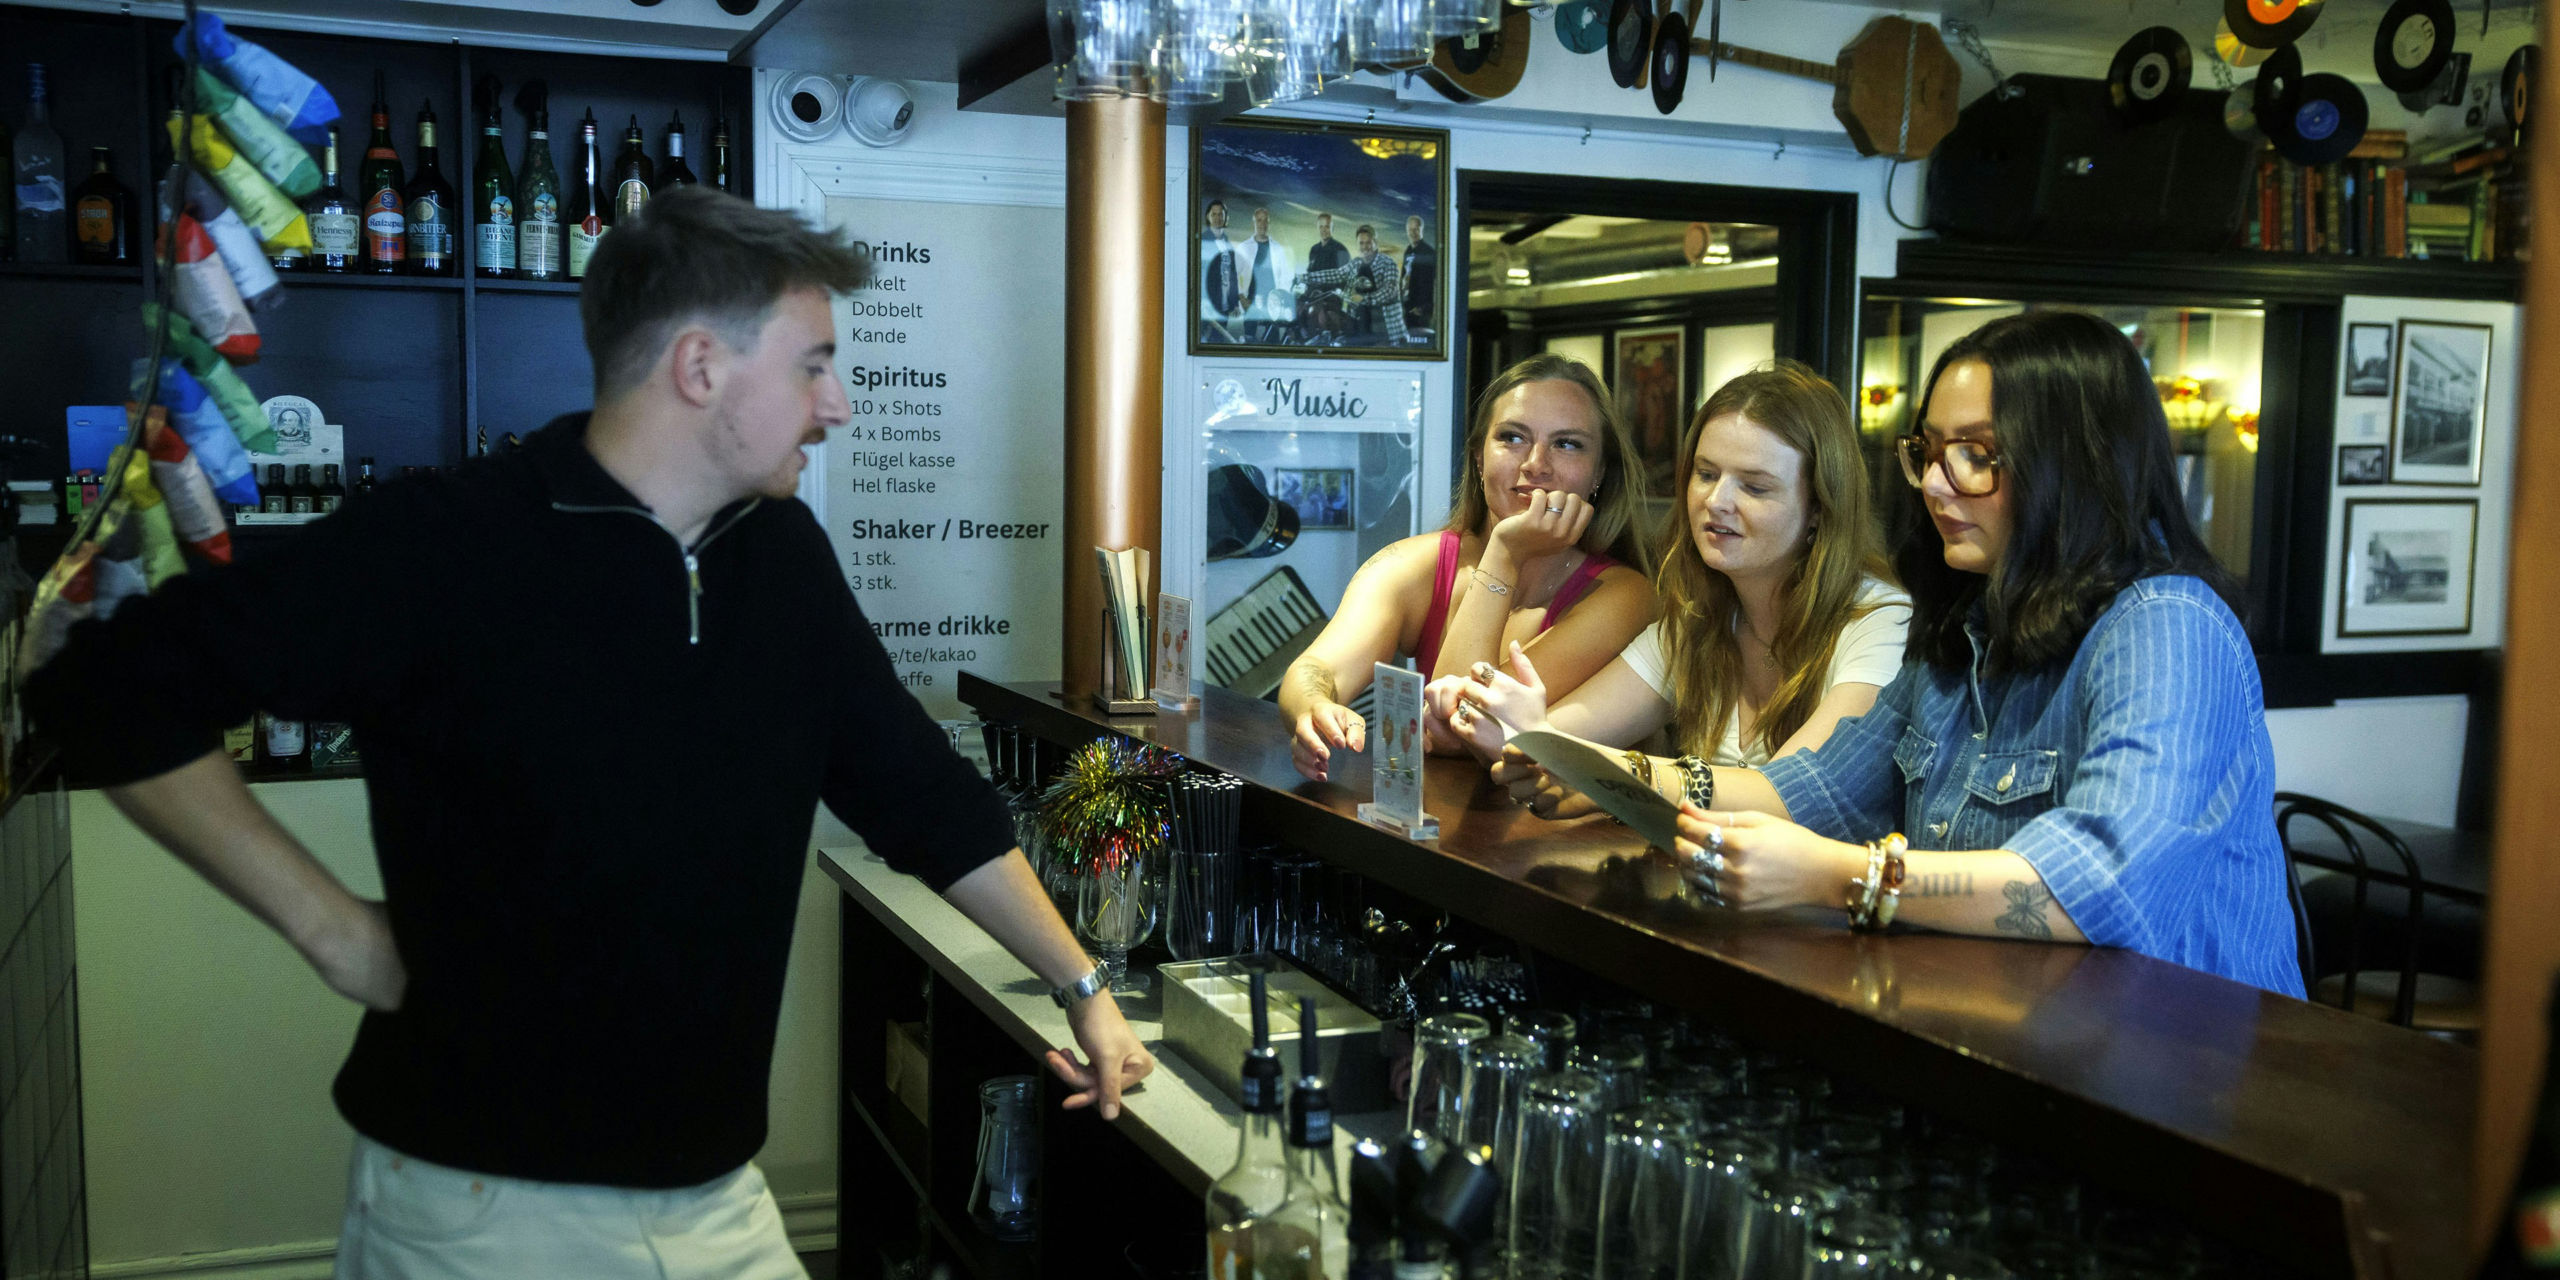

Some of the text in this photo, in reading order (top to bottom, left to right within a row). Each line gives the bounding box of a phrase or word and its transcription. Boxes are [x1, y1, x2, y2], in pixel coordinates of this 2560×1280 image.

[383, 194, 394, 203] 58
[81, 209, 107, 218] STROH
[317, 226, 352, 236] Hennessy
[852, 241, 931, 264] Drinks
[863, 275, 906, 291] nkelt
[852, 301, 923, 318] Dobbelt
[852, 328, 907, 343] Kande
[851, 366, 947, 392] Spiritus
[1266, 377, 1368, 419] Music
[852, 400, 941, 416] 10 x Shots
[852, 426, 941, 442] 4 x Bombs
[852, 451, 955, 472] Flügel kasse
[853, 478, 936, 493] Hel flaske
[852, 519, 1050, 541] Shaker / Breezer
[852, 550, 896, 566] 1 stk.
[852, 575, 897, 590] 3 stk.
[871, 615, 1010, 637] arme drikke
[900, 671, 933, 686] affe
